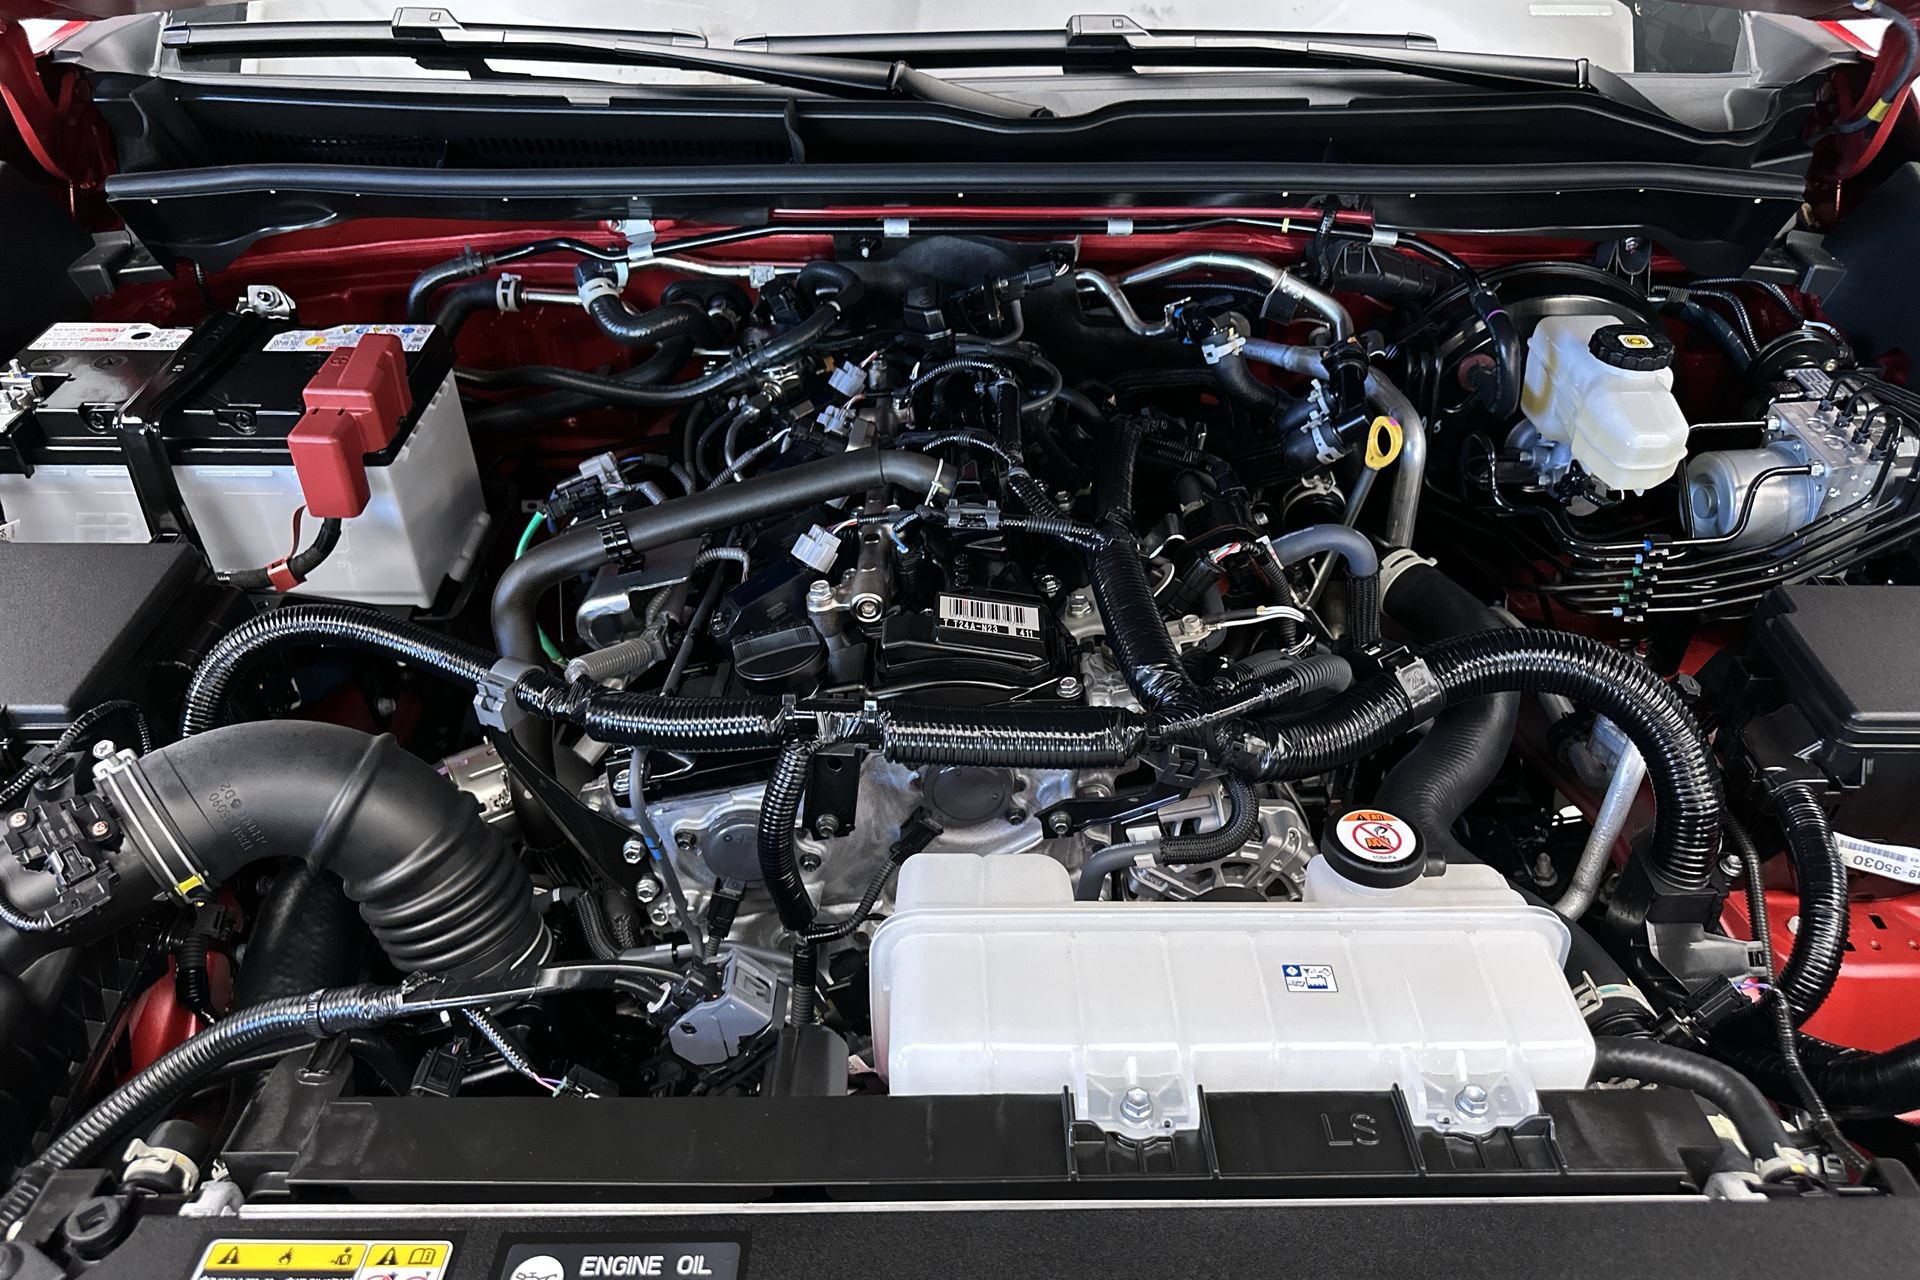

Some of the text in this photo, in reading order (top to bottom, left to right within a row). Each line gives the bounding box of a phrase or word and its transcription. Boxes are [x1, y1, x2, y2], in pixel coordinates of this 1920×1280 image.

[953, 619, 998, 633] T24A-N23
[1019, 629, 1034, 638] 411
[1320, 1112, 1379, 1146] LS
[579, 1255, 712, 1276] ENGINE OIL
